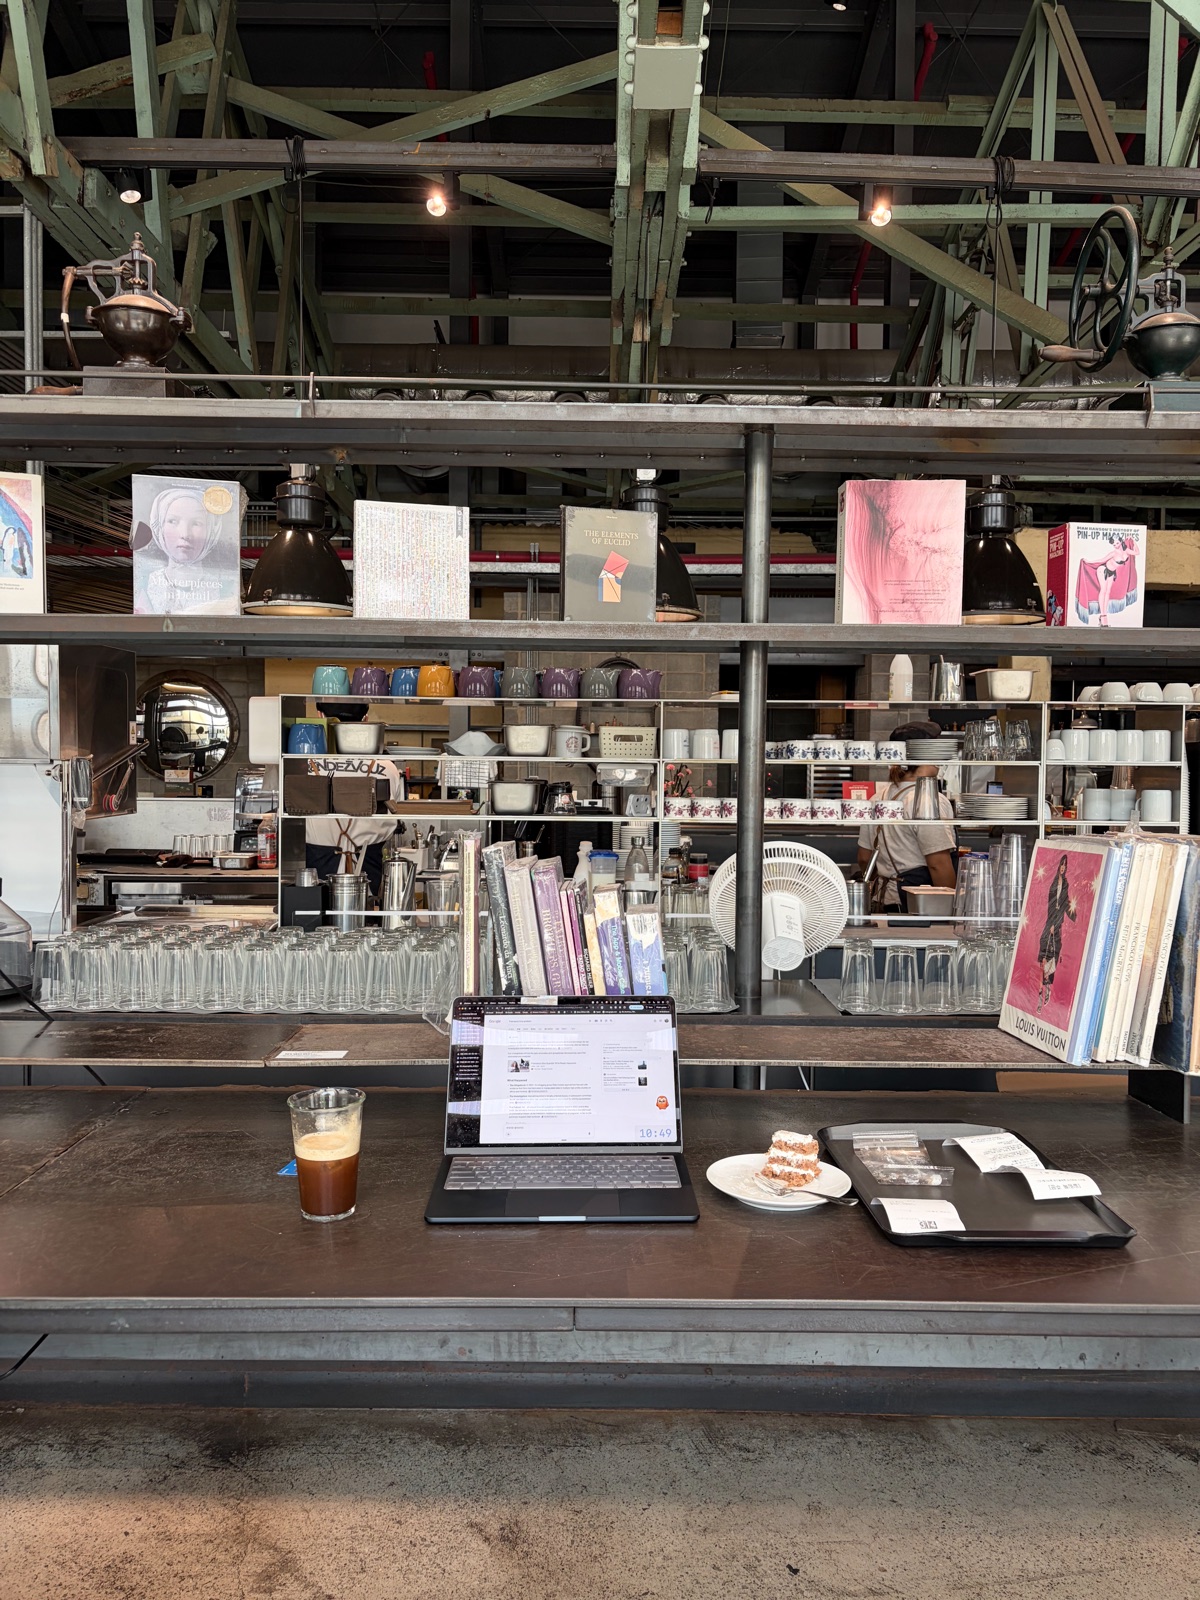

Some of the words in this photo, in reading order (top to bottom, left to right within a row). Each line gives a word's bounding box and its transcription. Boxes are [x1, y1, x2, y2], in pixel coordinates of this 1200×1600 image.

[601, 531, 639, 539] ELEMENTS
[1077, 530, 1100, 540] PIN-UP
[604, 538, 631, 546] EUCLID
[150, 576, 223, 591] Masterpieces
[176, 590, 210, 600] Detail
[308, 759, 387, 777] NDEZVOUZ
[500, 915, 510, 950] Leonardo
[1128, 922, 1140, 960] FRANCISCO
[504, 950, 510, 958] da
[1015, 1016, 1035, 1036] LOUIS
[1036, 1025, 1067, 1052] VUITTON
[639, 1128, 672, 1138] 10:49
